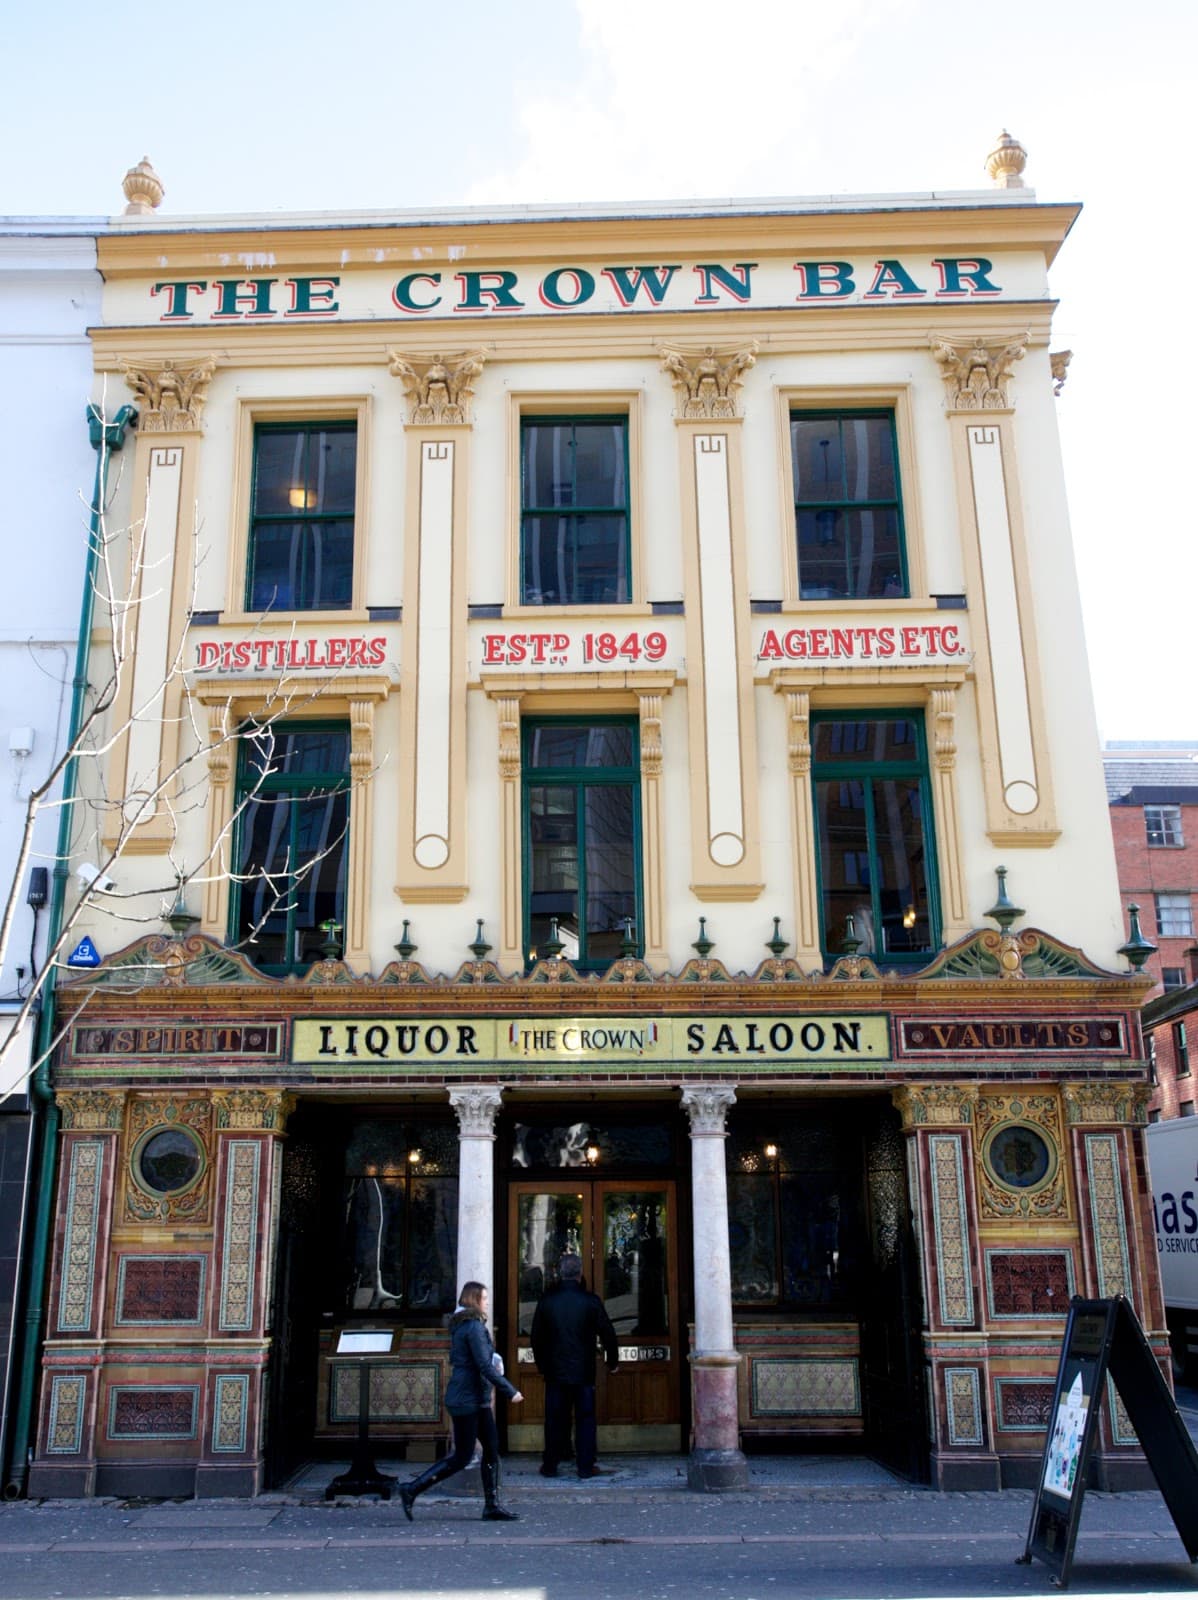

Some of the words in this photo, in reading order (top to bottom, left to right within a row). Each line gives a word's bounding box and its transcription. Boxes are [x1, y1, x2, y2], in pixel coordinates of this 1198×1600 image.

[151, 276, 341, 320] THE
[392, 263, 759, 312] CROWN
[793, 257, 1003, 301] BAR
[194, 637, 387, 673] DISTILLERS
[583, 632, 667, 663] 1849
[757, 628, 896, 660] AGENTS
[900, 625, 966, 657] ETC.
[113, 1028, 242, 1053] SPIRIT
[319, 1025, 480, 1058] LIQUOR
[520, 1029, 556, 1050] THE
[562, 1028, 646, 1051] CROWN
[687, 1022, 873, 1054] SALOON.
[930, 1023, 1090, 1048] VAULTS
